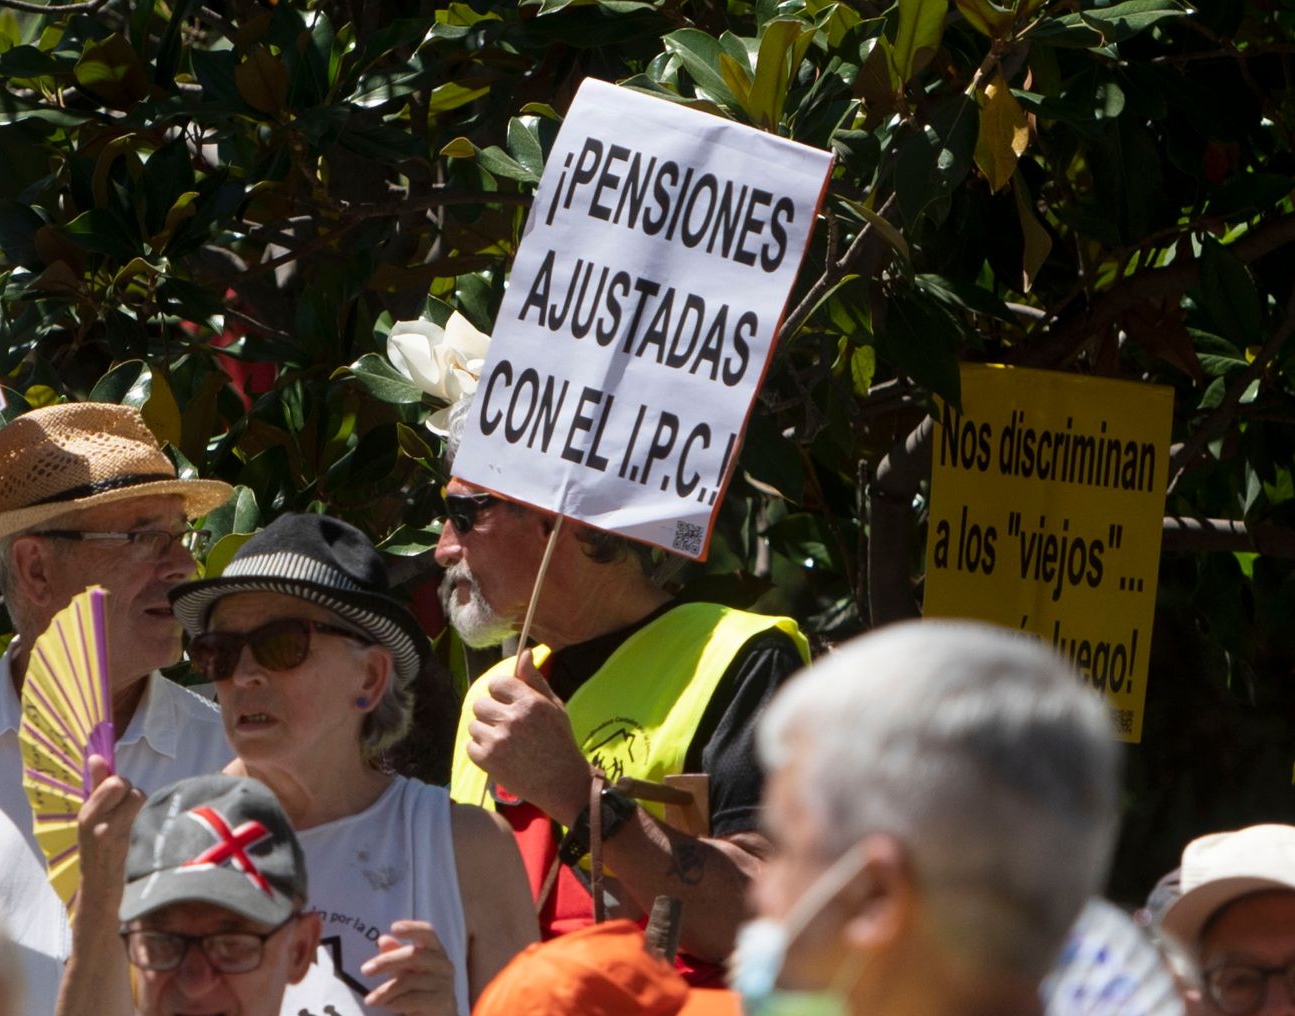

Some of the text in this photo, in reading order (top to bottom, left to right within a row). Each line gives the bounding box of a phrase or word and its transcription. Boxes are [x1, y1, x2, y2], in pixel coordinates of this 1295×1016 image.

[545, 136, 795, 273] ¡PENSIONES
[518, 249, 758, 387] AJUSTADAS
[480, 360, 569, 453] CON
[560, 385, 615, 472] EL
[940, 405, 1156, 493] Nos discriminan
[933, 518, 950, 569] a
[957, 505, 997, 576] los
